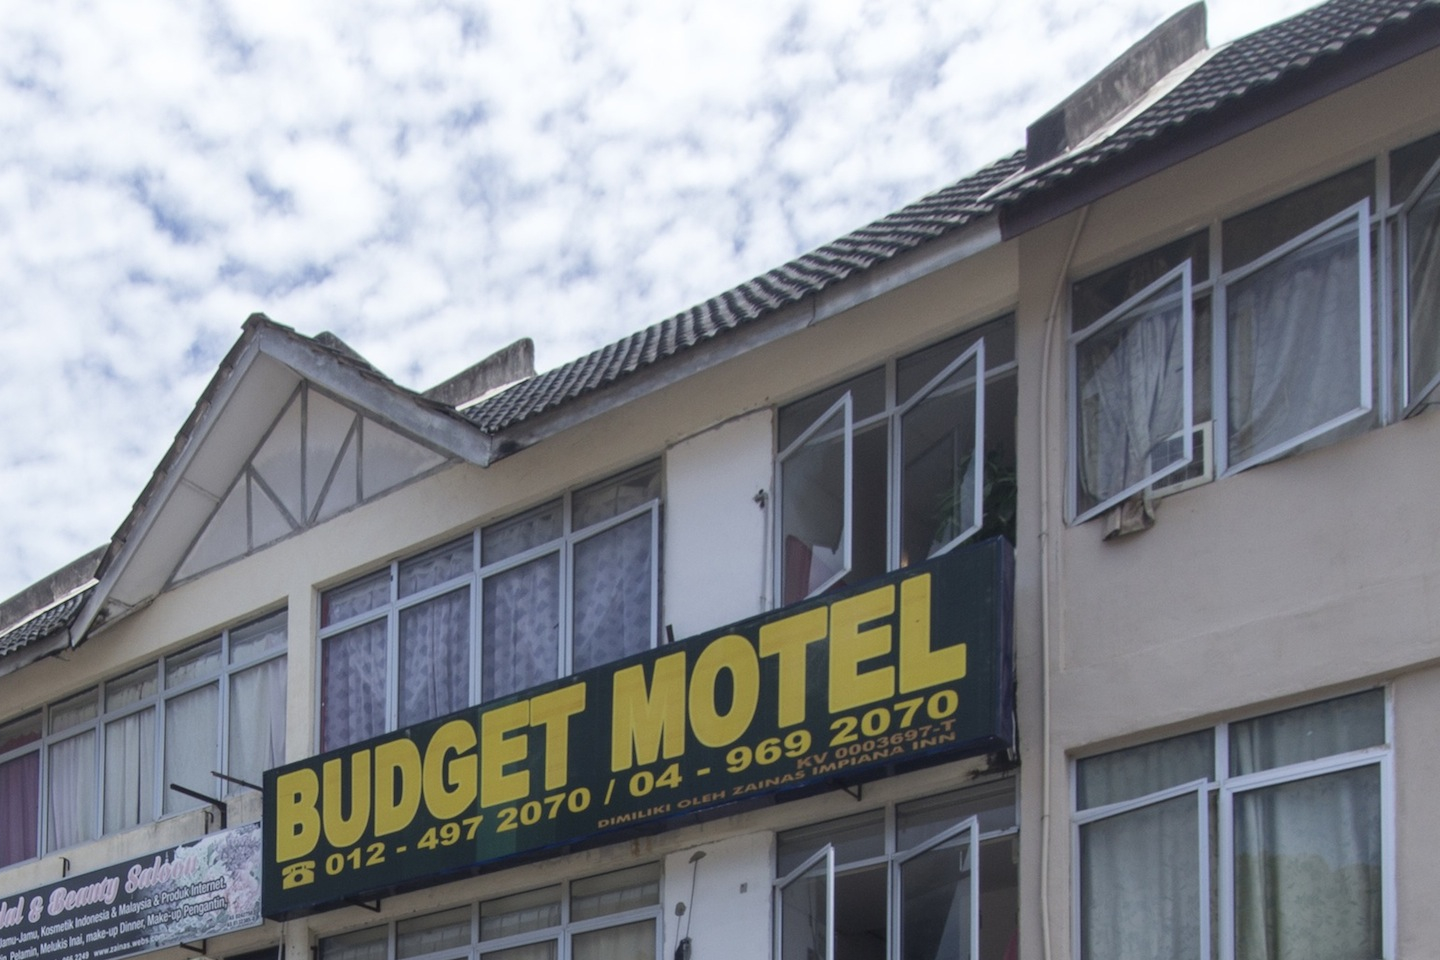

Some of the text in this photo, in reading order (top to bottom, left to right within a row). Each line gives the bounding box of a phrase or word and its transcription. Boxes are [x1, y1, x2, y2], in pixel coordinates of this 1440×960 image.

[276, 572, 967, 863] BUDGET MOTEL
[796, 719, 956, 769] KV 0003697-T
[325, 842, 385, 875] 012
[417, 815, 483, 851] 497
[496, 787, 591, 833] 2070
[629, 763, 683, 797] 04
[725, 729, 811, 773] 969
[829, 689, 959, 747] 2070
[598, 731, 956, 828] DIMILIKI OLEH ZAINAS IMPIANA INN
[28, 896, 43, 923] &
[48, 876, 120, 915] Beauty
[125, 856, 198, 894] Saloon
[41, 922, 74, 937] Kosmetik
[75, 909, 110, 928] Indonesia
[119, 898, 152, 917] Malaysia
[161, 887, 190, 903] Produk
[40, 940, 68, 956] Melukis
[86, 928, 118, 944] make-up
[147, 910, 182, 928] Make-up
